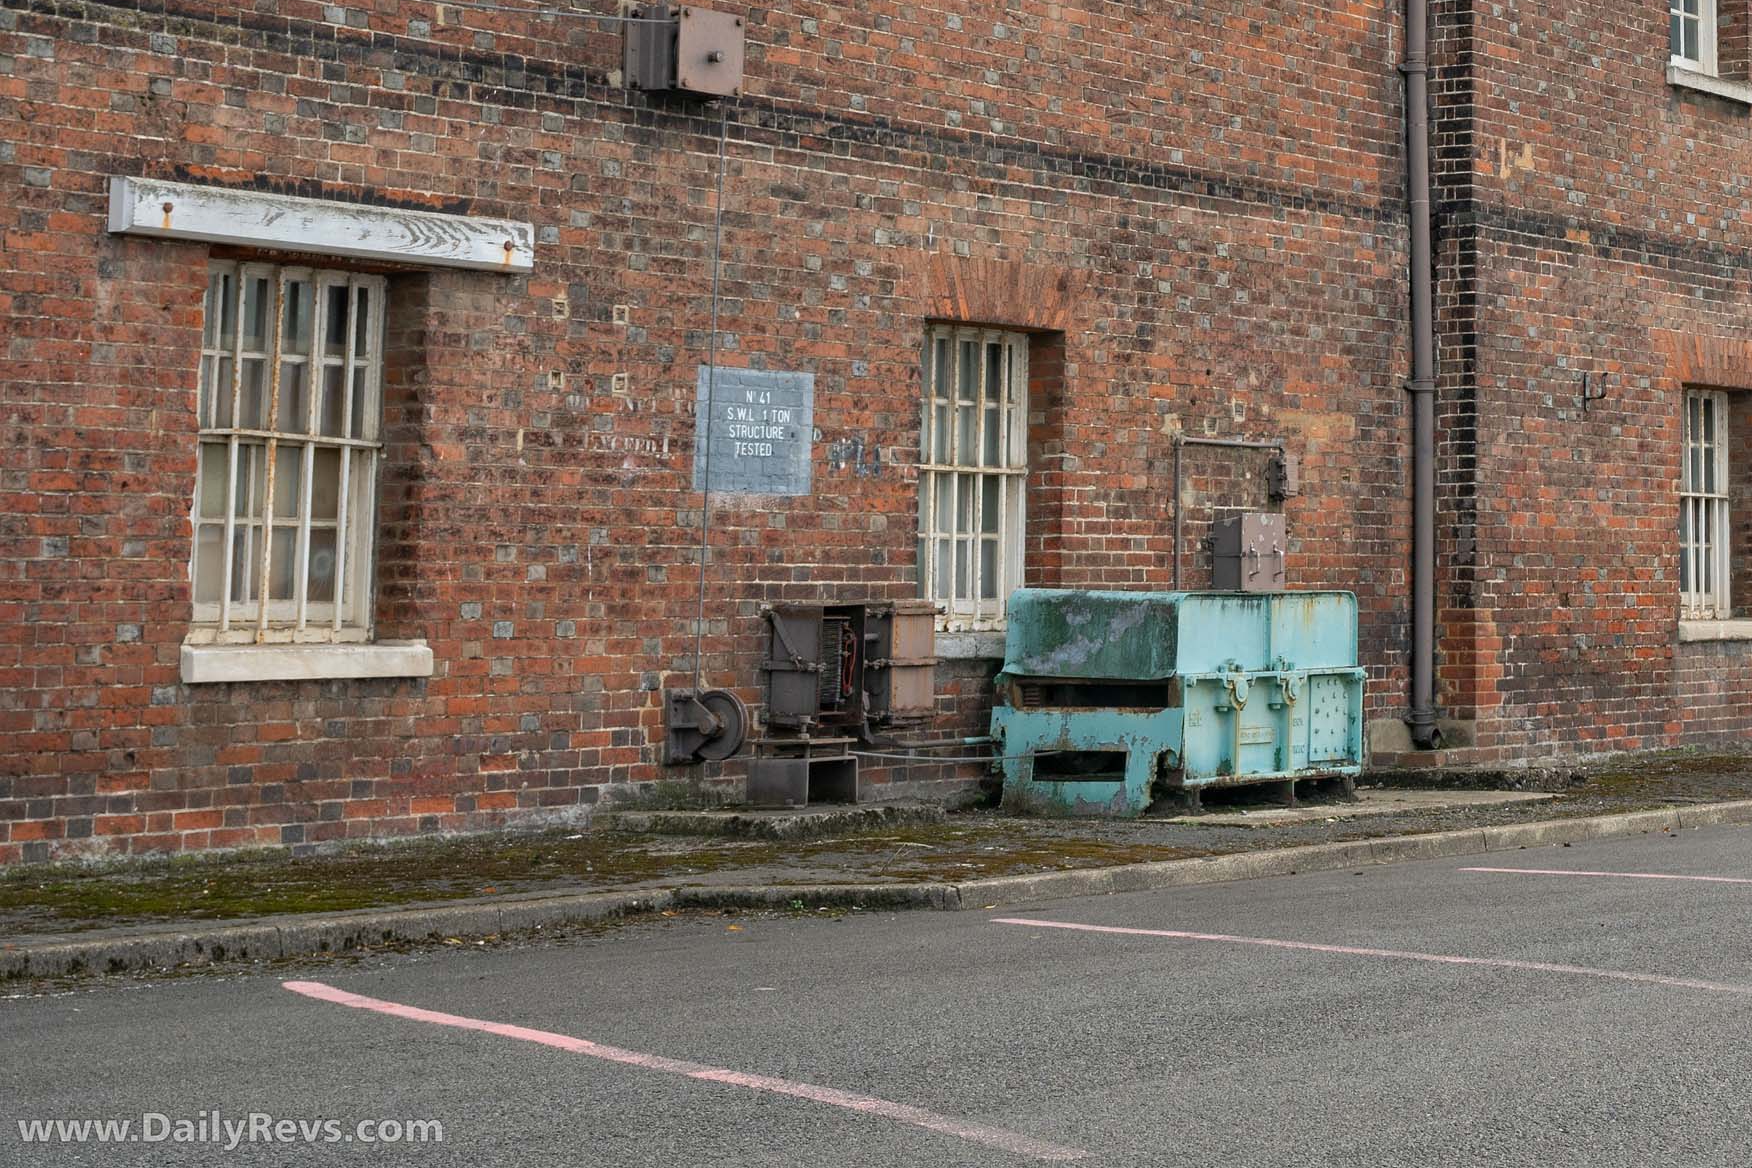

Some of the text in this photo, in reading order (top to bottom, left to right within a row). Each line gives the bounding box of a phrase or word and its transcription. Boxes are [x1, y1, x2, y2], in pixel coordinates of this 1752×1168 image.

[759, 391, 771, 404] 41
[762, 409, 768, 421] 1
[772, 409, 791, 423] TON
[729, 424, 785, 440] STRUCTURE
[735, 441, 773, 457] TESTED
